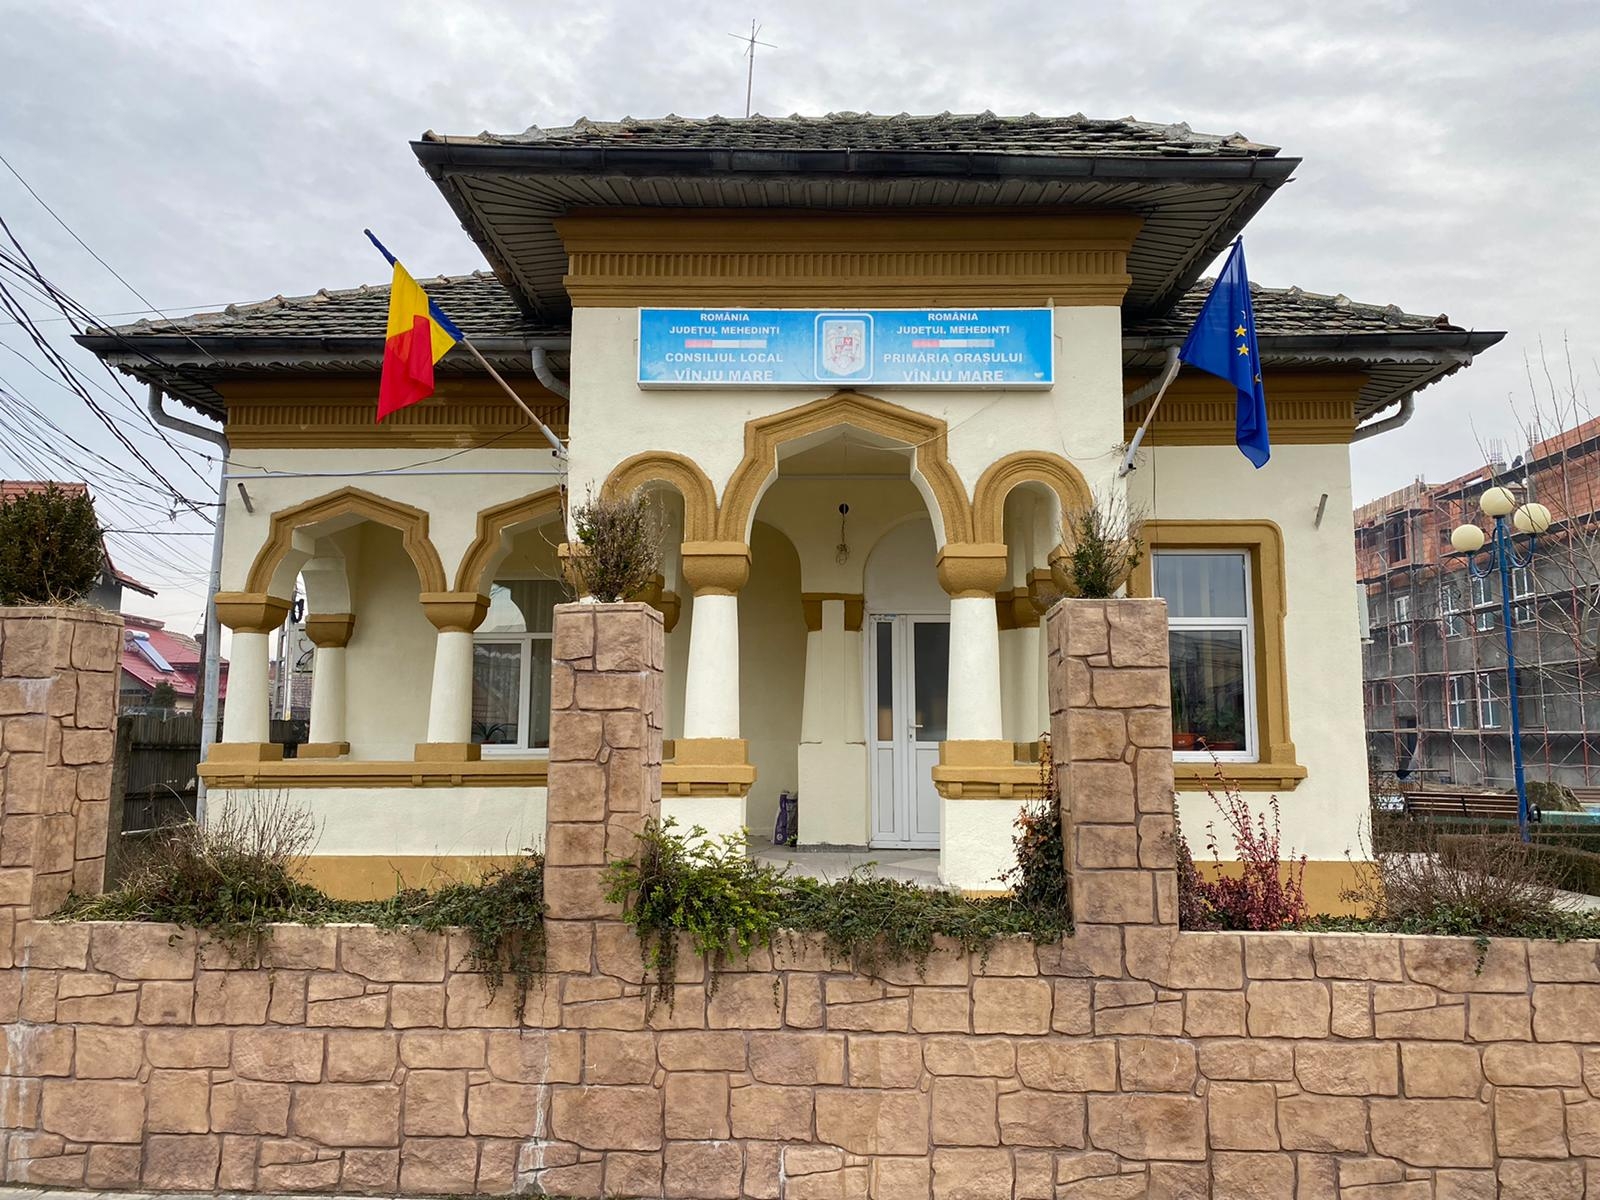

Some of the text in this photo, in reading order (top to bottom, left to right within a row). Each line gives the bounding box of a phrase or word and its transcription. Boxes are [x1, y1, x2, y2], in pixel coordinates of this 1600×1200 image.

[700, 312, 750, 322] ROMÂNIA
[927, 312, 979, 321] ROMÂNIA
[665, 352, 784, 363] CONSILIUL LOCAL
[728, 370, 774, 381] MARE
[958, 370, 1005, 382] MARE
